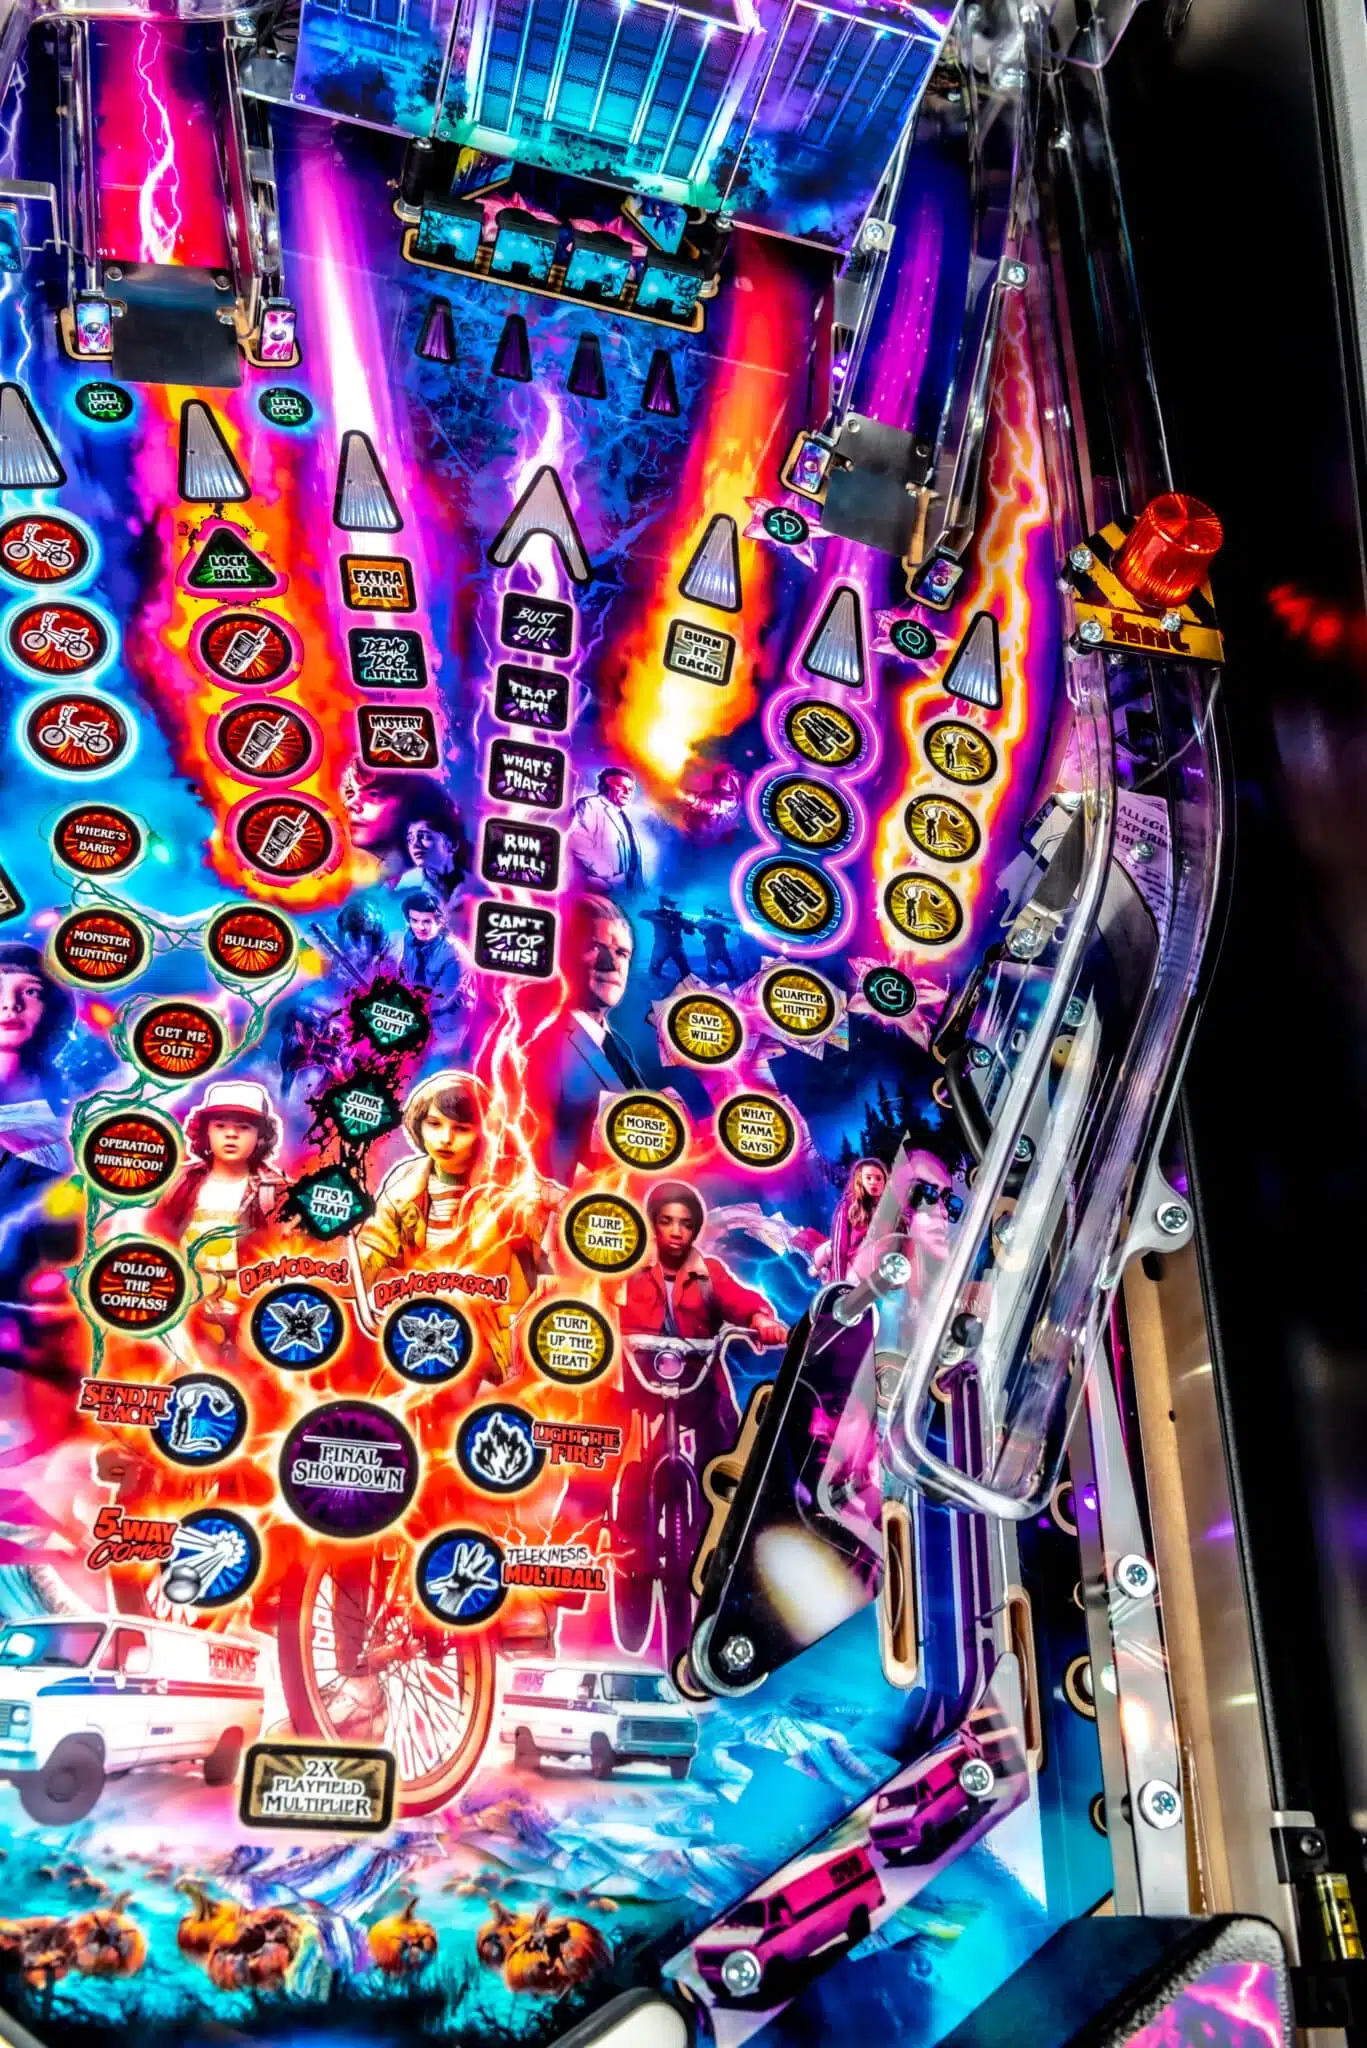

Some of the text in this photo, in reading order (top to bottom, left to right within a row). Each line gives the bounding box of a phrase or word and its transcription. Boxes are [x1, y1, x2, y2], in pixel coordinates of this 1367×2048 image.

[89, 391, 117, 402] LITE
[272, 397, 297, 407] LITE
[89, 401, 120, 412] LOCK
[273, 406, 302, 417] LOCK
[211, 555, 248, 567] LOCK
[213, 568, 250, 580] BALL
[353, 569, 402, 586] EXTRA
[360, 584, 401, 600] BALL
[514, 607, 566, 626] BUST
[518, 624, 556, 641] OUT!
[684, 629, 722, 649] BURN
[359, 636, 409, 658] DEMO
[694, 646, 707, 659] IT
[373, 655, 408, 670] DOG
[677, 656, 720, 677] BACK!
[364, 668, 417, 681] ATTACK
[508, 680, 558, 699] TRAP
[370, 716, 422, 729] MYSTERY
[503, 753, 552, 777] WHAT'S
[505, 770, 547, 793] THAT?
[75, 824, 126, 842] WHERE'S
[79, 840, 116, 856] BARB?
[504, 834, 540, 855] RUN
[497, 854, 546, 877] WILL!
[488, 912, 544, 930] CAN'T
[73, 929, 131, 948] MONSTER
[224, 934, 279, 952] BULLIES!
[485, 929, 545, 949] STOP
[69, 946, 128, 964] HUNTING!
[489, 949, 538, 966] THIS!
[774, 987, 824, 1004] QUARTER
[374, 1004, 412, 1024] BREAK
[783, 1003, 815, 1018] HUNT!
[374, 1019, 404, 1036] OUT!
[690, 1013, 720, 1028] SAVE
[155, 1025, 207, 1043] GET ME
[690, 1028, 720, 1043] WILL!
[160, 1044, 195, 1059] OUT!
[349, 1091, 380, 1110] JUNK
[343, 1106, 379, 1124] YARD!
[740, 1108, 773, 1122] WHAT
[626, 1117, 667, 1132] MORSE
[740, 1123, 773, 1138] MAMA
[99, 1136, 165, 1155] OPERATION
[627, 1133, 663, 1149] CODE!
[740, 1139, 772, 1154] SAYS!
[94, 1153, 163, 1172] MIRKWOOD!
[315, 1186, 351, 1204] IT'S A
[312, 1203, 348, 1219] TRAP!
[591, 1216, 621, 1230] LURE
[588, 1234, 623, 1249] DART!
[113, 1261, 167, 1279] FOLLOW
[240, 1257, 349, 1294] DEMODOG!
[124, 1278, 150, 1293] THE
[374, 1273, 508, 1309] DEMOGORGON!
[101, 1293, 167, 1312] COMPASS!
[555, 1317, 589, 1330] TURN
[549, 1335, 593, 1350] UP THE
[552, 1354, 589, 1368] HEAT!
[82, 1384, 171, 1412] SEND IT
[97, 1402, 158, 1425] BACK
[534, 1423, 620, 1449] LIGHT THE
[321, 1446, 381, 1466] FINAL
[552, 1445, 604, 1467] FIRE
[294, 1460, 403, 1492] SHOWDOWN
[95, 1508, 177, 1542] 5-WAY
[507, 1547, 589, 1565] TELEKINESIS
[504, 1564, 606, 1589] MULTIBALL
[305, 1760, 335, 1779] 2X
[275, 1779, 363, 1796] PLAYFIELD
[264, 1795, 369, 1816] MULTIPLIER
